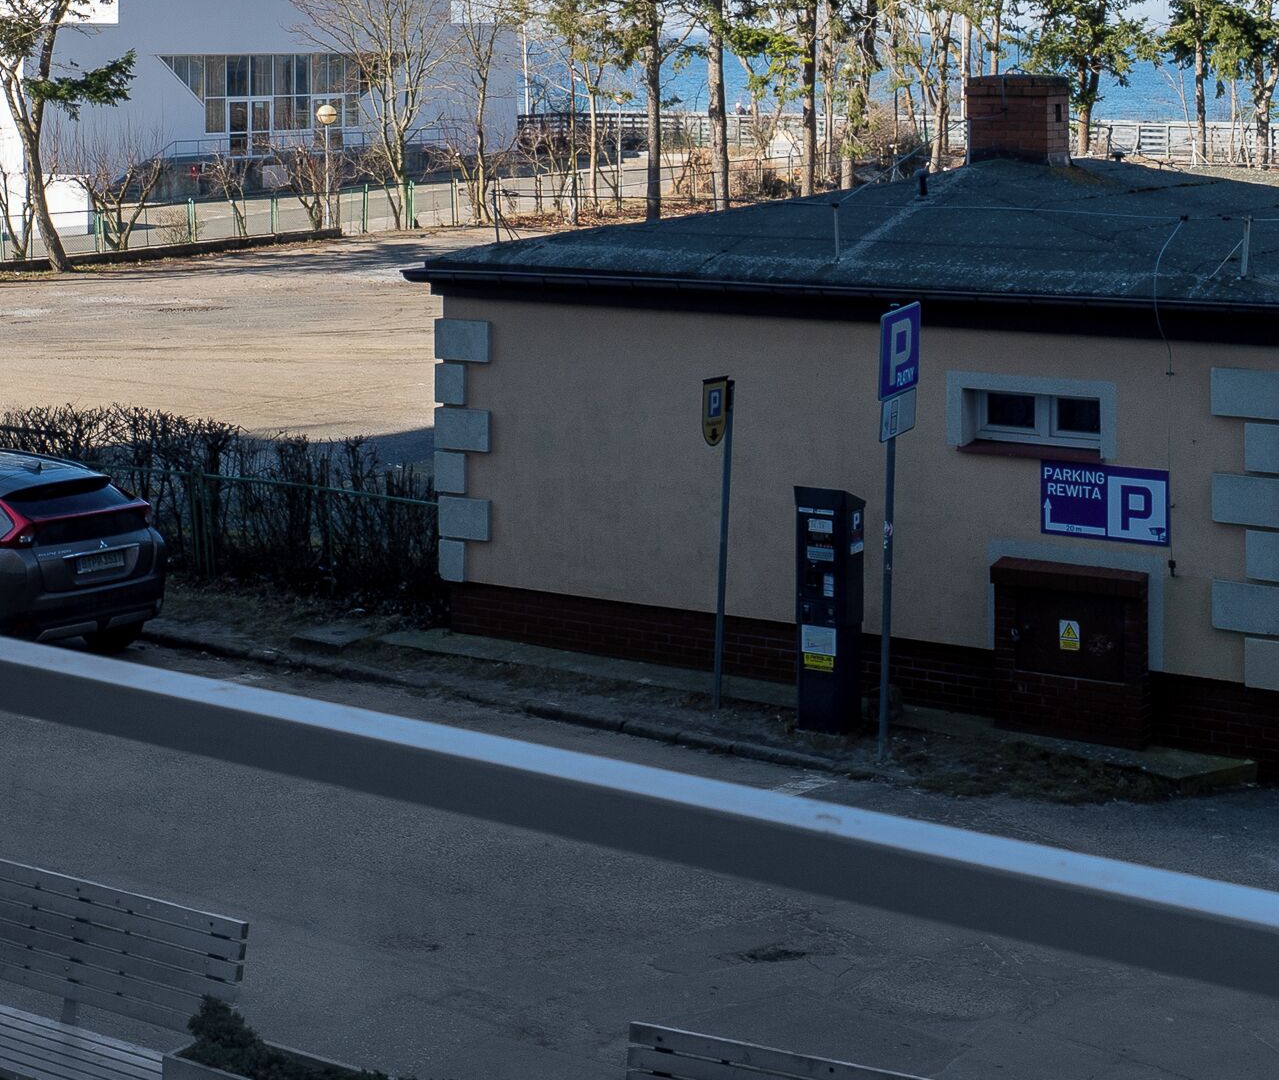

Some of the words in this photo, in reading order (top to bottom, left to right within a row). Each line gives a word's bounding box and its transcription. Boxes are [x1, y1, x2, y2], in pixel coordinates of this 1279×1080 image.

[889, 318, 912, 386] P
[710, 391, 720, 416] P
[1043, 466, 1105, 485] PARKING
[1047, 482, 1102, 500] REWITA
[1120, 484, 1153, 531] P
